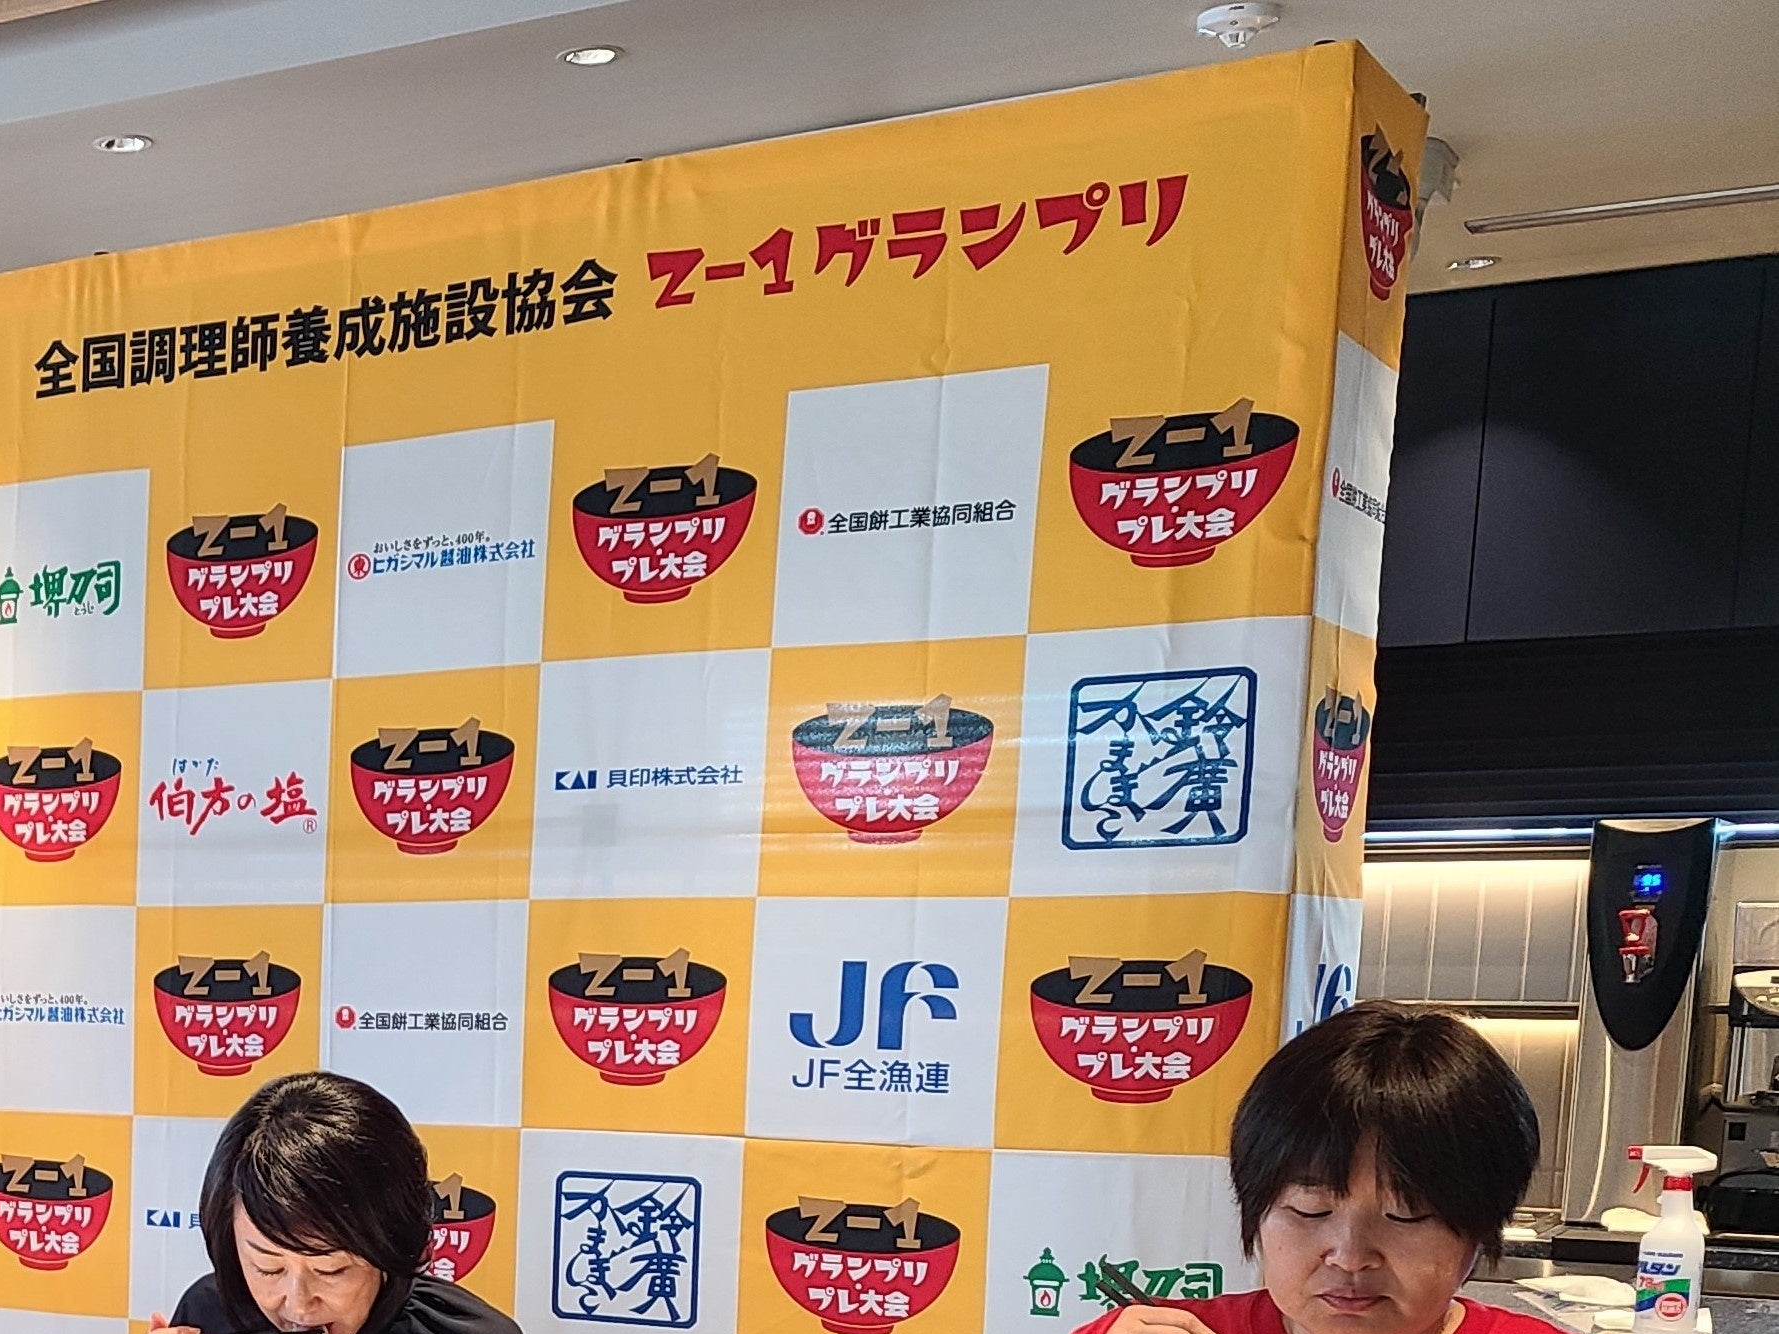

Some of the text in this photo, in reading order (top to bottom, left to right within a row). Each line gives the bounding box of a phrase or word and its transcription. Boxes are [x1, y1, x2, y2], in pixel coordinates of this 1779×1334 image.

[35, 257, 619, 399] 全国調理師養成施設協会
[1099, 467, 1259, 510] グランプリ
[827, 499, 1016, 535] 全国餅工業協同組合
[1117, 510, 1236, 545] プレ大会
[596, 516, 725, 551] グランプリ
[187, 560, 294, 591] グランプリ
[611, 551, 707, 583] プレ大会
[30, 560, 121, 619] 堺刀司
[199, 592, 279, 620] プレ大会
[555, 765, 743, 790] KAI 貝印株式会社
[820, 758, 960, 787] グランプリ
[373, 776, 488, 802] グランプリ
[3, 790, 98, 818] グランプリ
[149, 772, 317, 836] 伯方の塩
[835, 794, 940, 822] プレ大会
[15, 820, 87, 844] プレ大会
[386, 806, 472, 835] プレ大会
[174, 1003, 278, 1027] グランプリ
[359, 1012, 508, 1032] 全国餅工業協同組合
[573, 1006, 698, 1035] グランプリ
[1059, 1014, 1215, 1046] グランプリ
[187, 1033, 265, 1059] プレ大会
[587, 1039, 681, 1066] プレ大会
[792, 1058, 951, 1094] JF全漁連
[1077, 1051, 1192, 1081] プレ大会
[146, 1209, 181, 1228] KAI
[8, 1229, 79, 1255] プレ大会
[792, 1252, 929, 1286] グランプリ
[809, 1287, 910, 1318] プレ大会
